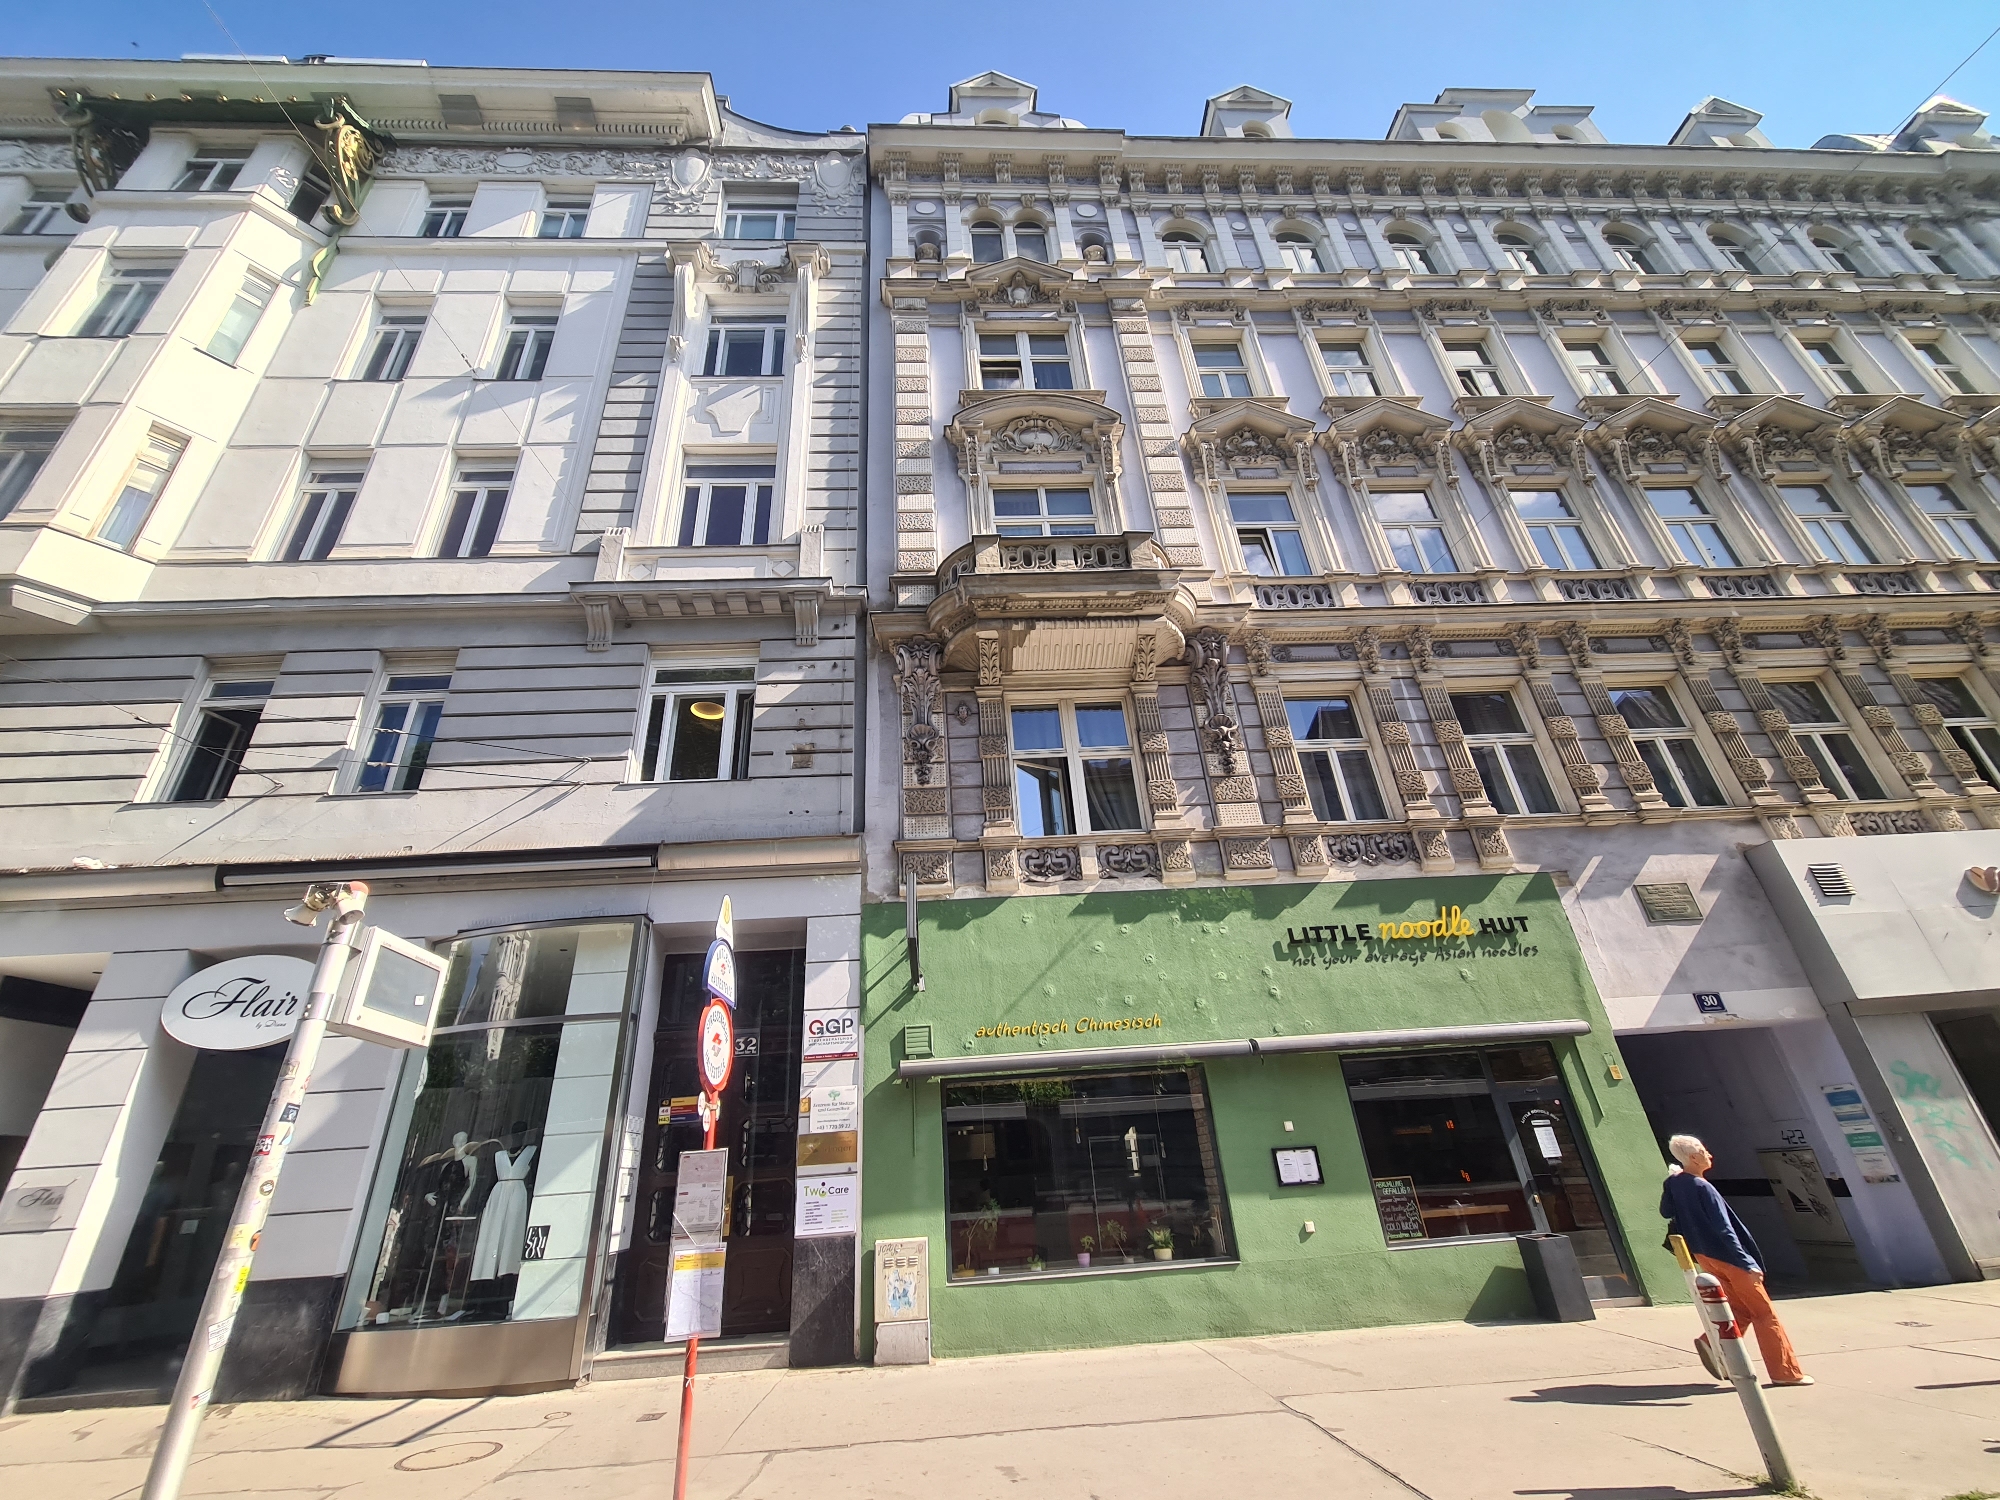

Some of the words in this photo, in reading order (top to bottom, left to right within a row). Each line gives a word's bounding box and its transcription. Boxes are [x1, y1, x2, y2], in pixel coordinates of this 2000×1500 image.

[1287, 924, 1373, 944] LITTLE
[1378, 905, 1475, 940] noodle
[1478, 916, 1529, 935] HUT
[1292, 954, 1317, 967] not
[1323, 954, 1357, 970] your
[1364, 951, 1428, 968] average
[1434, 948, 1476, 962] Asian
[1481, 944, 1539, 958] noodles
[181, 976, 298, 1020] Flair
[1701, 995, 1718, 1007] 30
[808, 1018, 854, 1036] GGP
[975, 1019, 1069, 1038] authentisch
[1075, 1013, 1162, 1034] Chinesisch
[735, 1036, 757, 1051] 32
